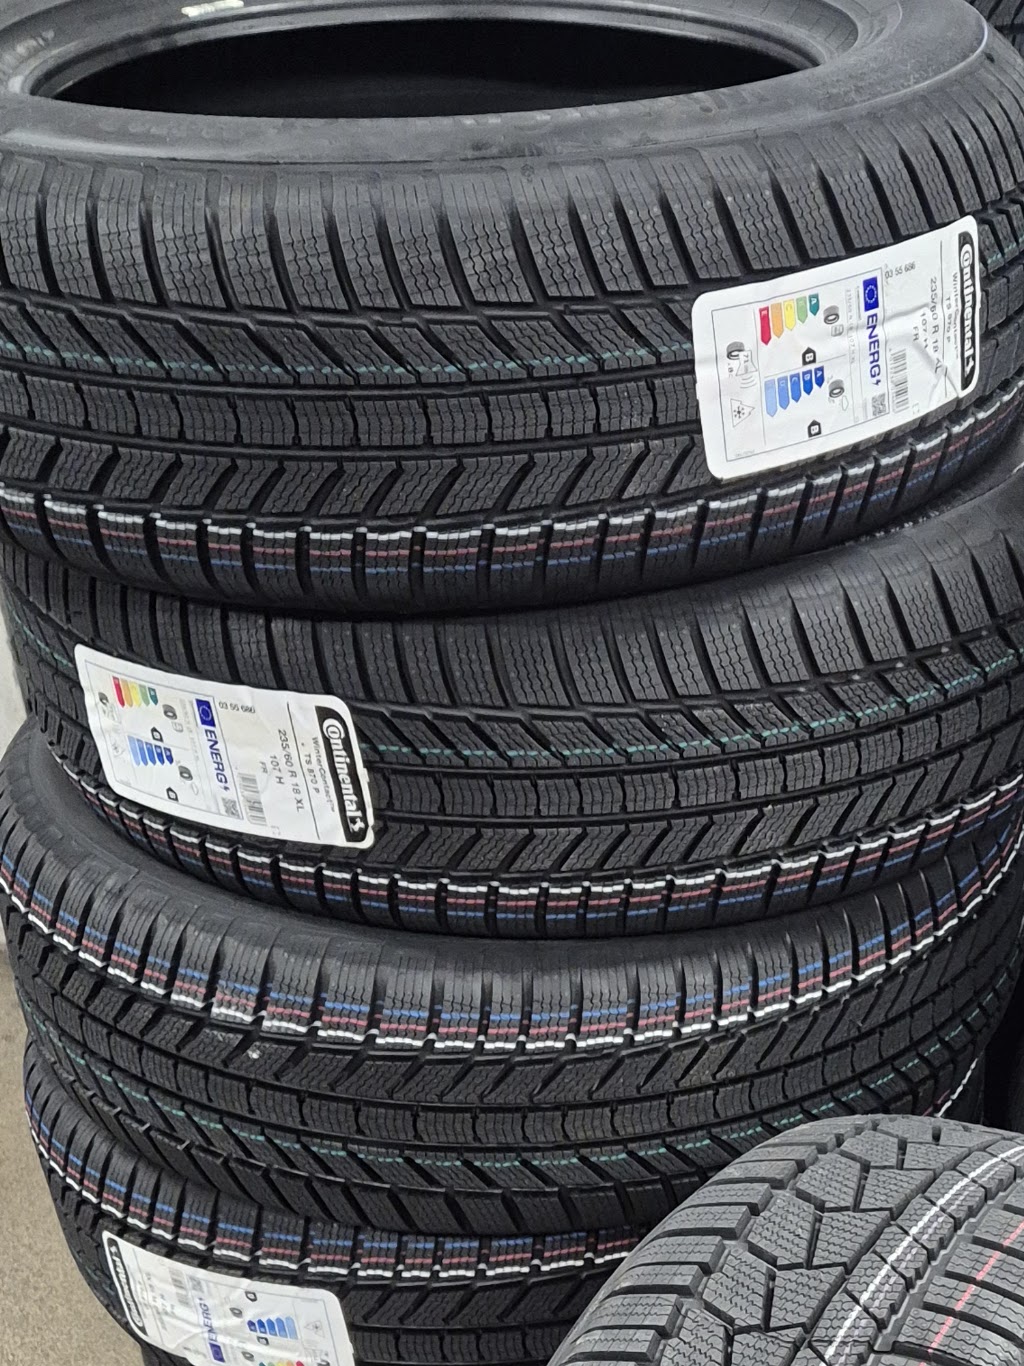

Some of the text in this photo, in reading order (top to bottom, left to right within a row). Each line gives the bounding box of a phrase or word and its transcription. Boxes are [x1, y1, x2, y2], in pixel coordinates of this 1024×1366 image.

[929, 277, 938, 321] 235/60
[960, 243, 975, 358] Continental
[912, 326, 920, 342] FR
[920, 312, 928, 333] 107
[931, 325, 940, 335] R
[204, 728, 228, 785] ENERG
[277, 728, 305, 812] 235/60 R 18 XL
[304, 753, 312, 765] TS
[322, 718, 363, 817] Continental
[275, 776, 285, 785] H
